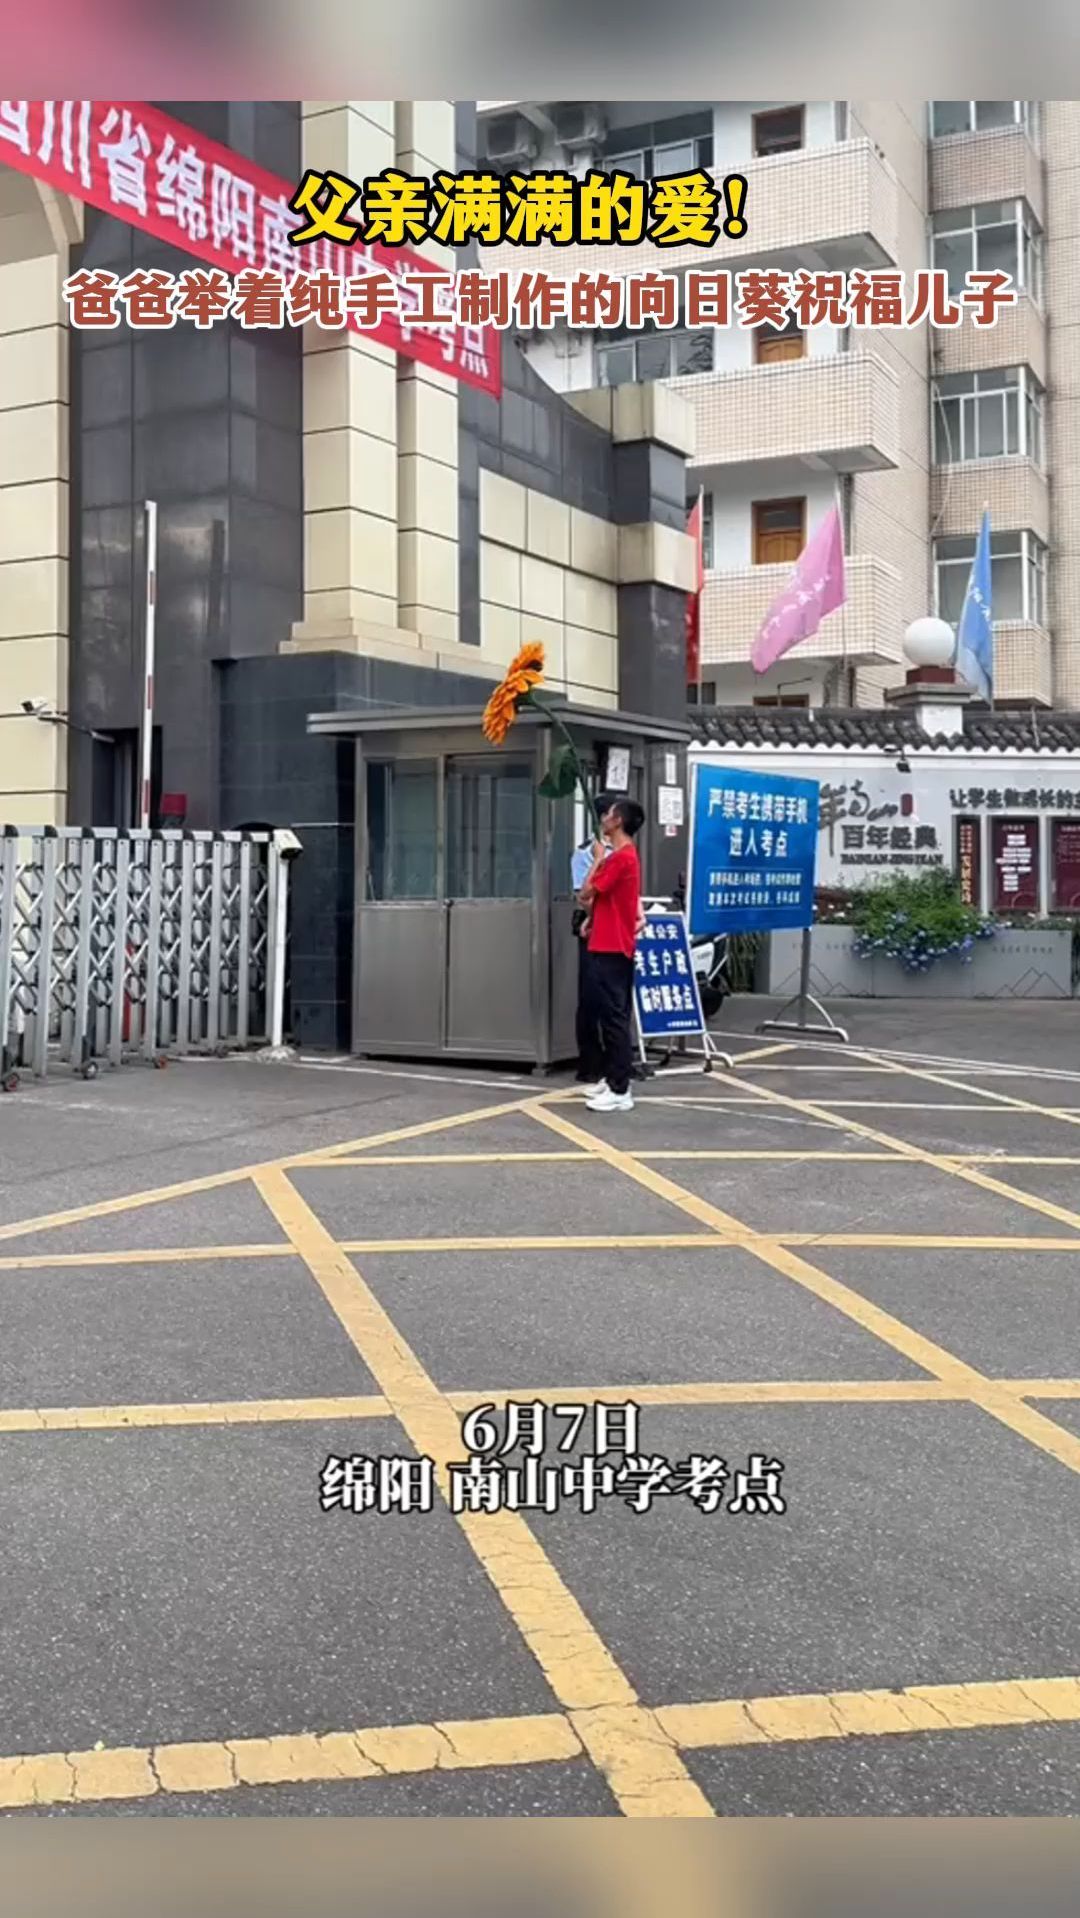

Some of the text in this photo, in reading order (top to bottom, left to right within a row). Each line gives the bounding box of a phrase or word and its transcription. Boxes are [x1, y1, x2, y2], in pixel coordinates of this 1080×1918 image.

[707, 787, 808, 825] 严禁考生携带手机
[841, 825, 938, 850] 百年经典
[635, 923, 678, 940] 城公安
